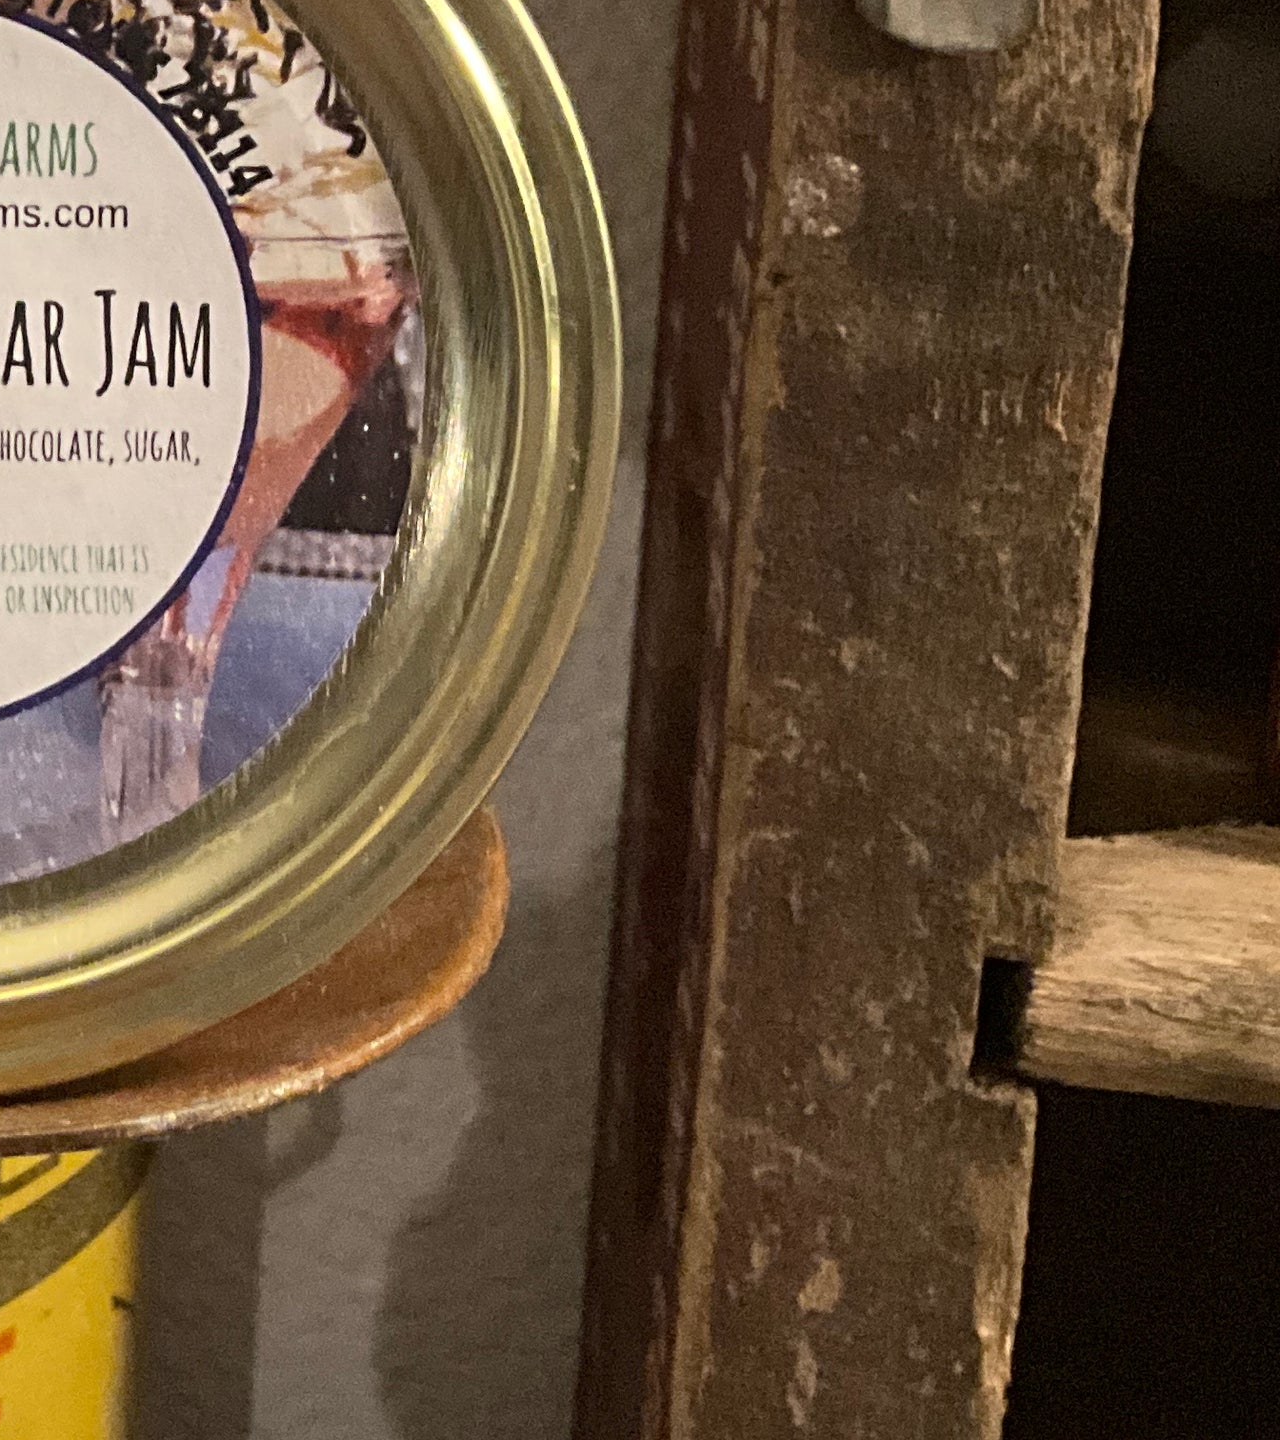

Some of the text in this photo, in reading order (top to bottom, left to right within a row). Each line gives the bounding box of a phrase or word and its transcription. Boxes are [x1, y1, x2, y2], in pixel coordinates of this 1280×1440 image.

[94, 288, 212, 398] JAM
[122, 427, 201, 467] SUGAR,
[87, 543, 126, 574] THAT
[131, 543, 150, 574] IS
[6, 584, 26, 616] OR
[32, 584, 135, 616] INSPECTION
